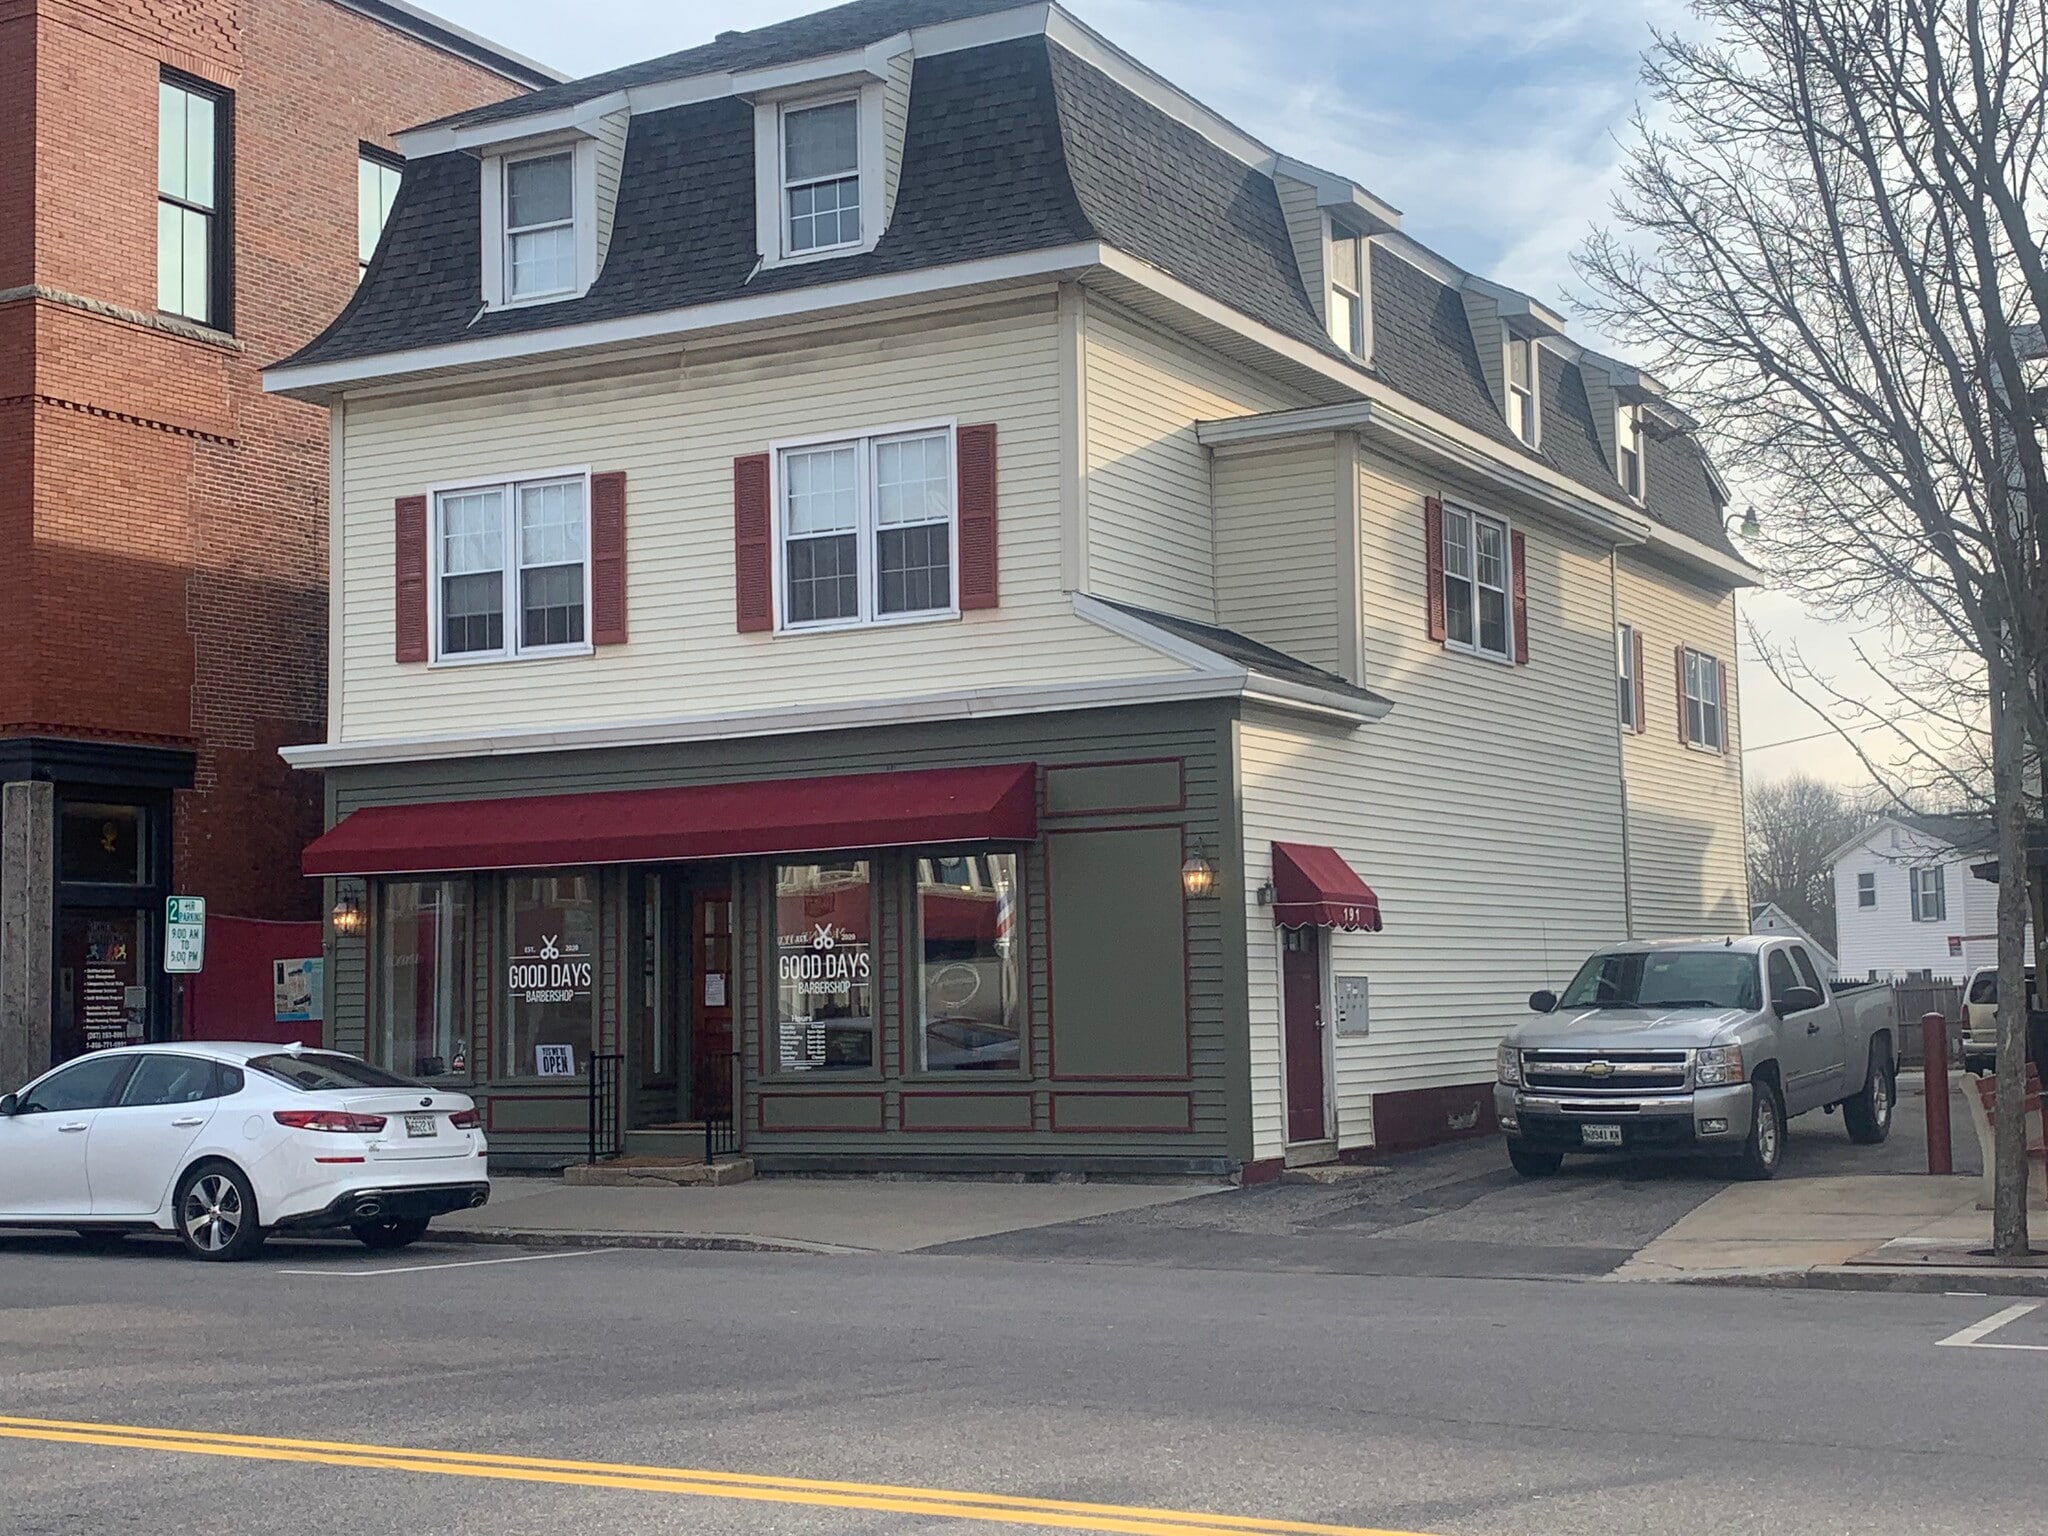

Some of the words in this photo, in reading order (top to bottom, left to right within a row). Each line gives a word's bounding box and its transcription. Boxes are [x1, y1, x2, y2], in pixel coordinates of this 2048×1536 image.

[169, 900, 179, 921] 2
[178, 912, 204, 922] PARKING
[1343, 907, 1360, 922] 191
[189, 929, 199, 939] AM
[181, 940, 190, 950] TO
[188, 951, 198, 961] PM
[780, 954, 821, 980] GOOD
[826, 952, 869, 978] DAYS
[509, 964, 547, 988] GOOD
[551, 962, 591, 987] DAYS
[798, 981, 850, 995] BARBERSHOP
[525, 989, 573, 1003] BARBERSHOP
[543, 1056, 569, 1073] OPEN
